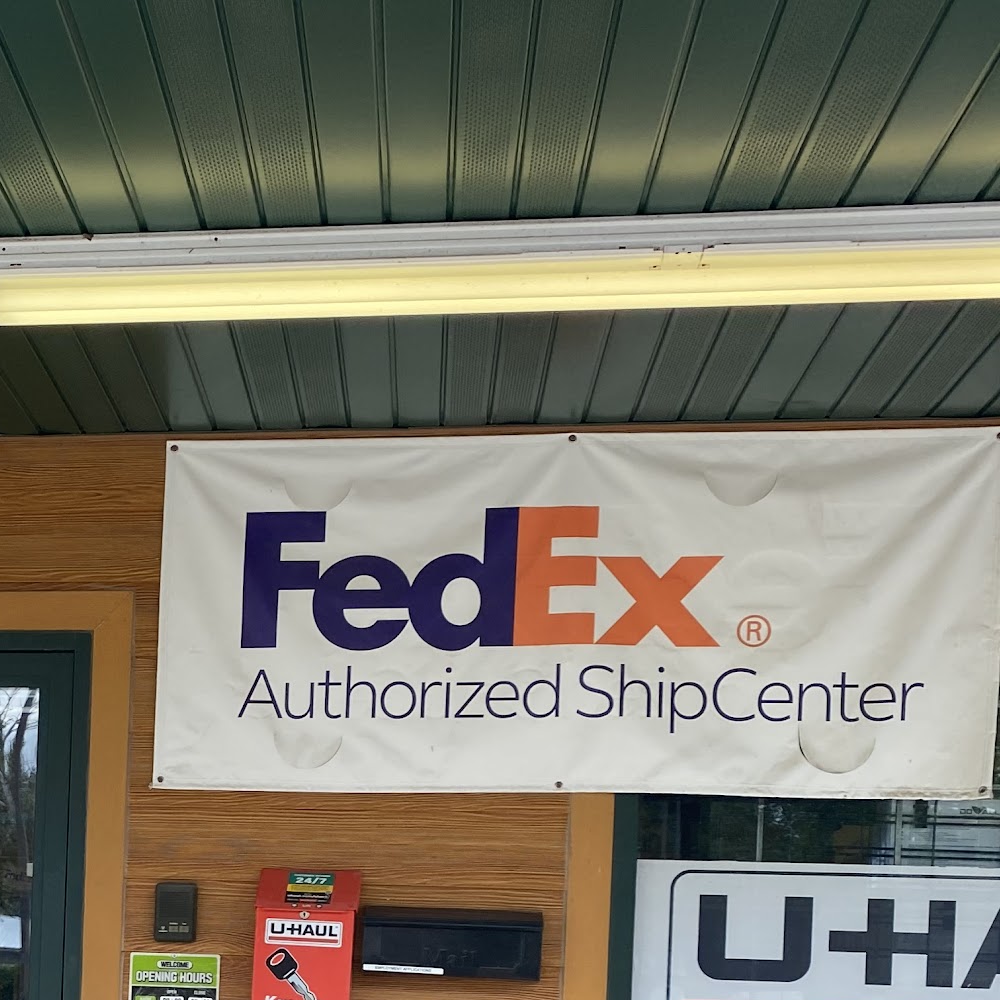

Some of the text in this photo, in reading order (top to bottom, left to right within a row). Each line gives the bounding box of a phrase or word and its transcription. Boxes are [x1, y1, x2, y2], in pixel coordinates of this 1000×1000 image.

[240, 506, 724, 651] FedEx
[237, 664, 924, 733] Authorized ShipCenter
[270, 922, 338, 937] U-HAUL
[135, 970, 213, 984] OPENING HOURS
